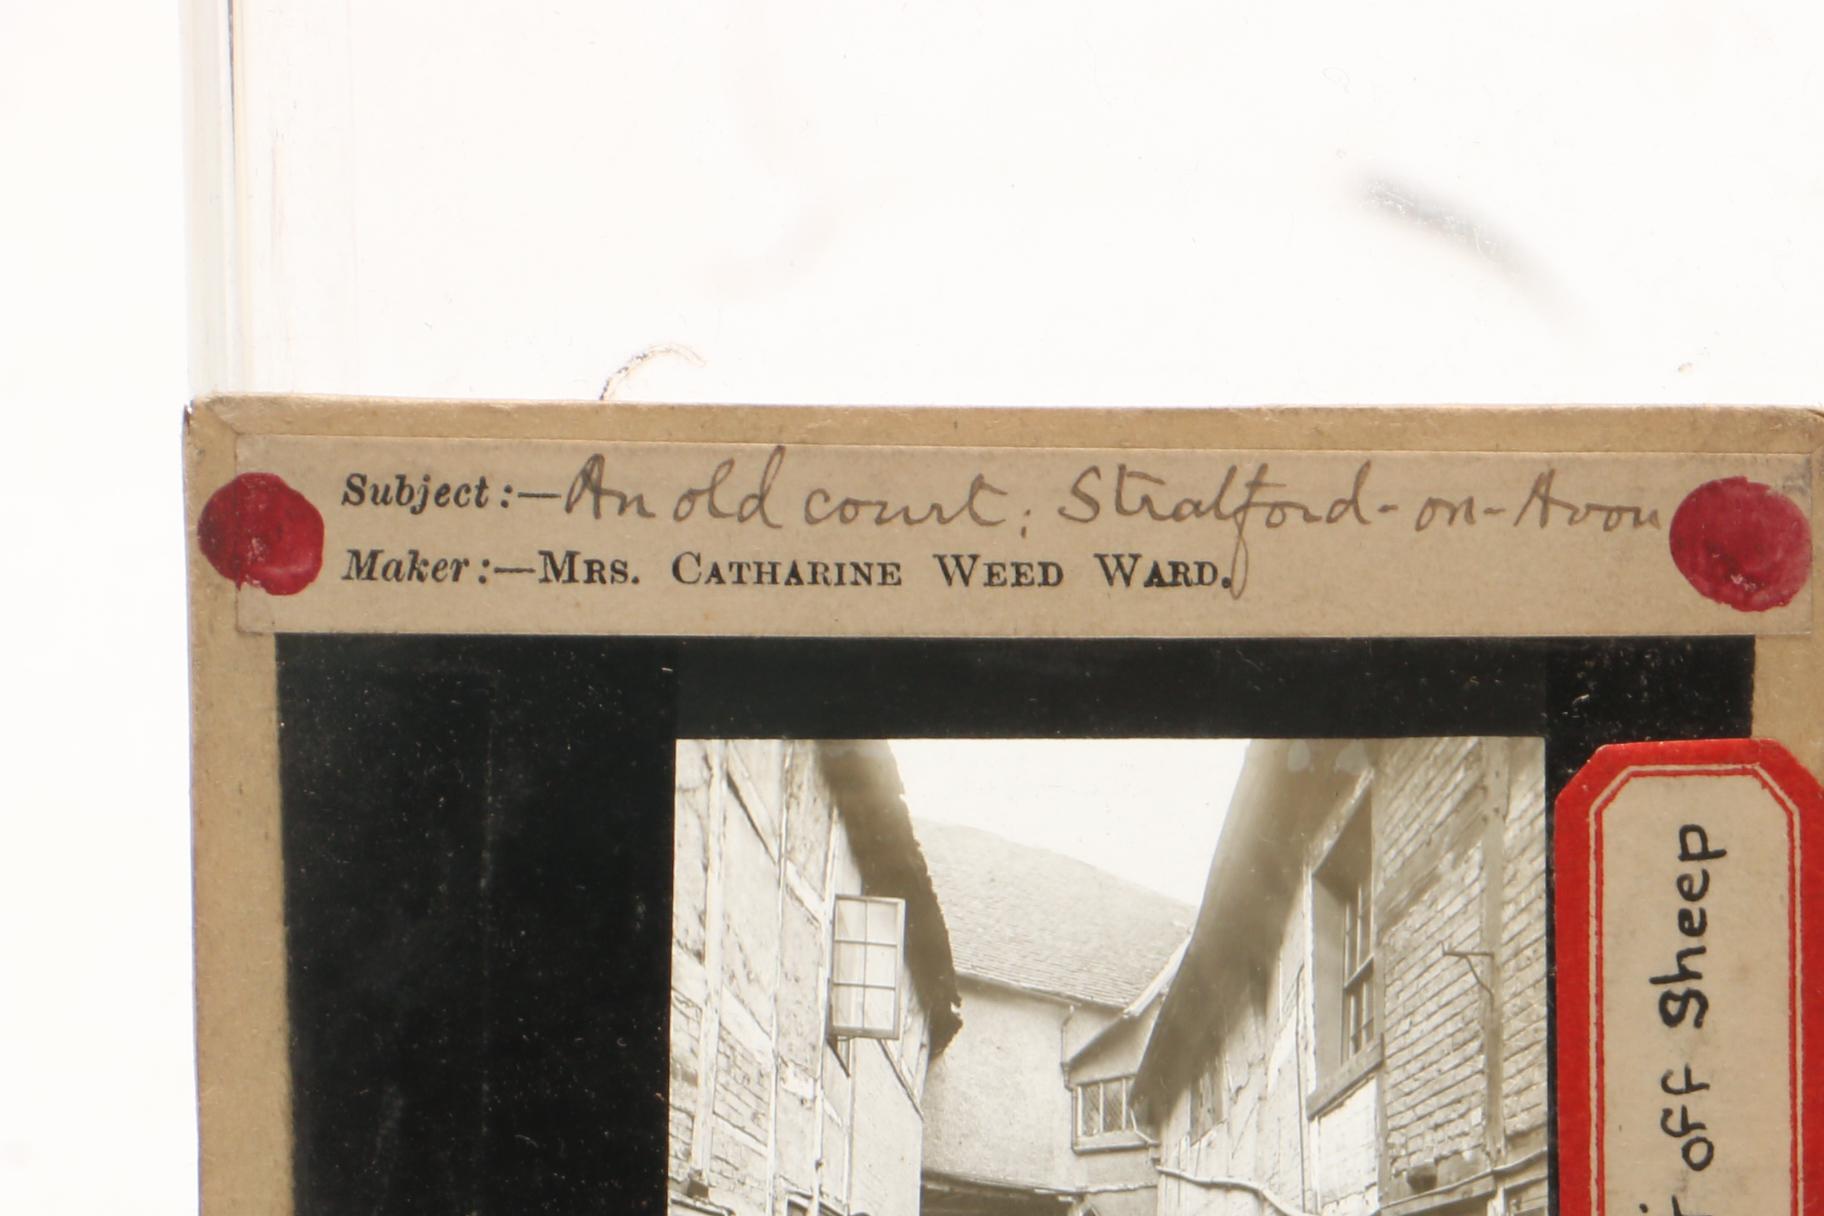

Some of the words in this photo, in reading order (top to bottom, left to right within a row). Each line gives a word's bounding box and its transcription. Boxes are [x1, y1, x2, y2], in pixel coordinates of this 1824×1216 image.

[670, 446, 787, 530] old
[670, 552, 904, 588] CATHARINE
[933, 552, 1065, 588] WEED
[1093, 553, 1237, 588] WARD.
[1650, 824, 1727, 1029] Sheep
[1660, 1063, 1715, 1172] off
